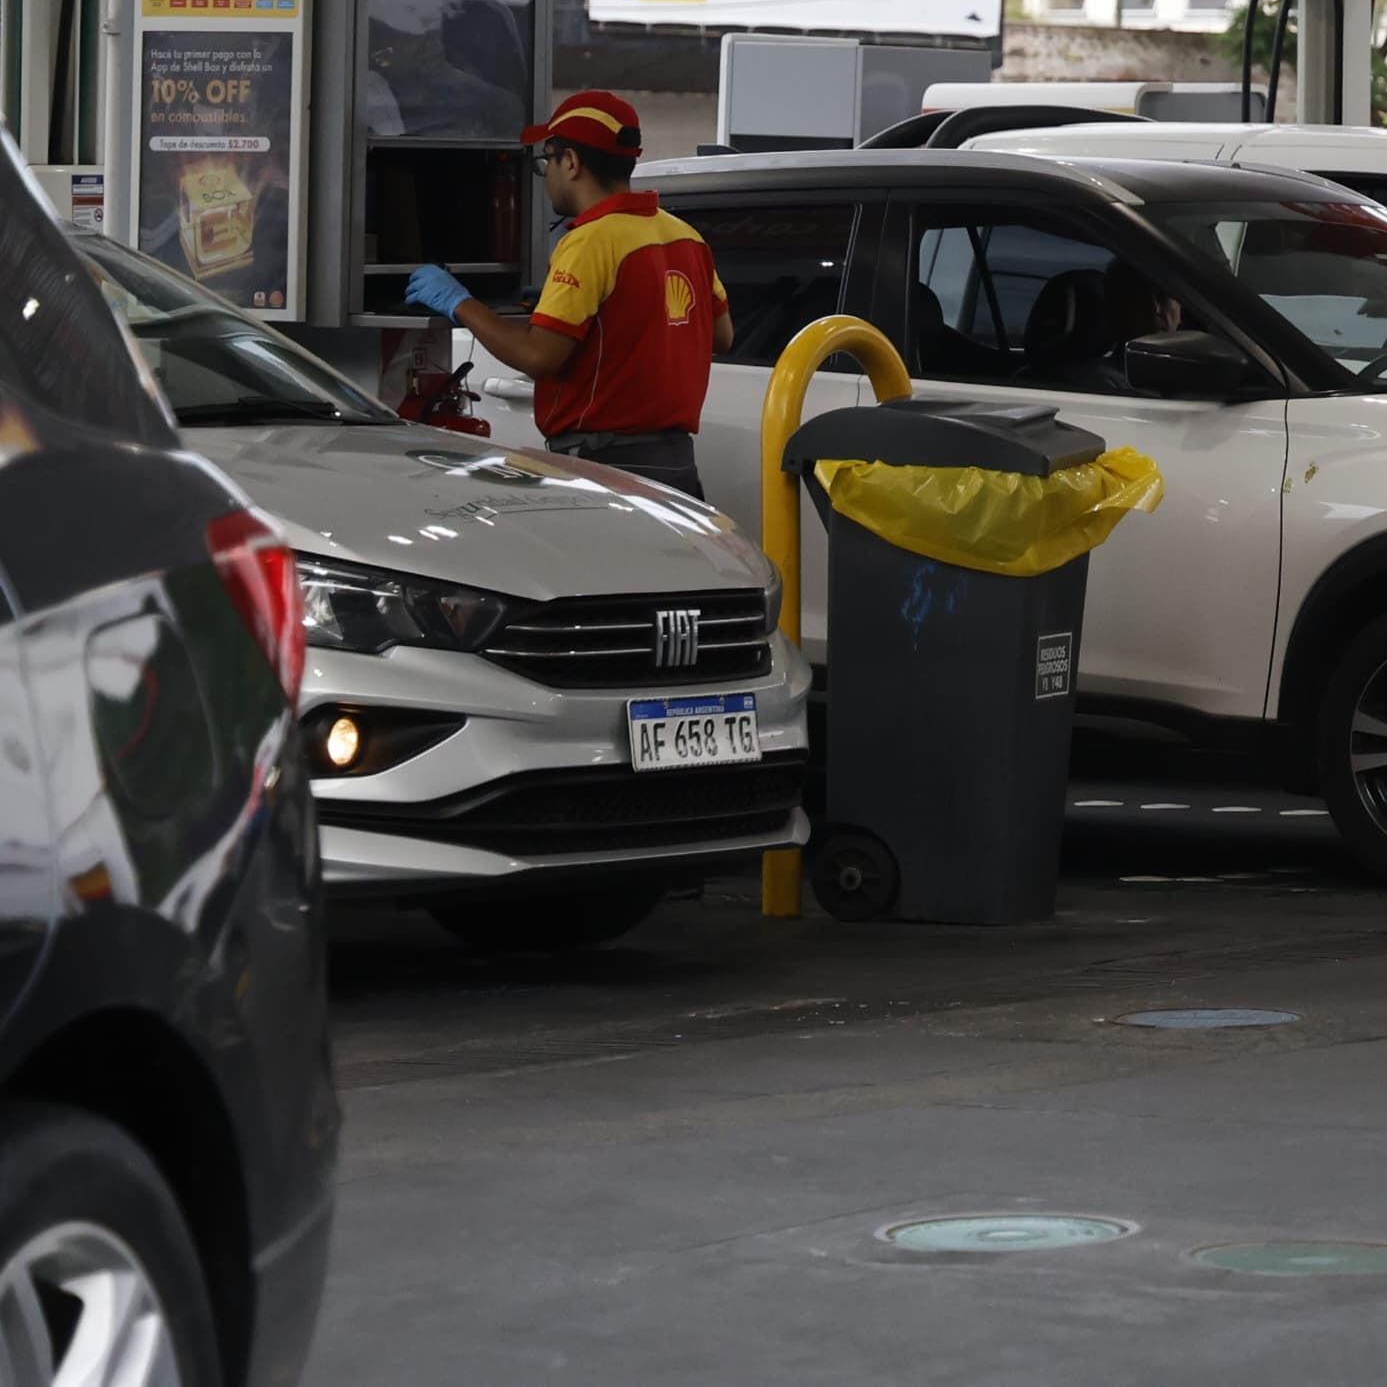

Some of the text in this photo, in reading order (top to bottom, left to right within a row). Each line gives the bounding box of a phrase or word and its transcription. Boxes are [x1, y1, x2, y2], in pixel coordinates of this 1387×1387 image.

[152, 78, 252, 103] 10% OFF
[656, 609, 701, 667] FIAT
[640, 716, 755, 762] AF 658 TG
